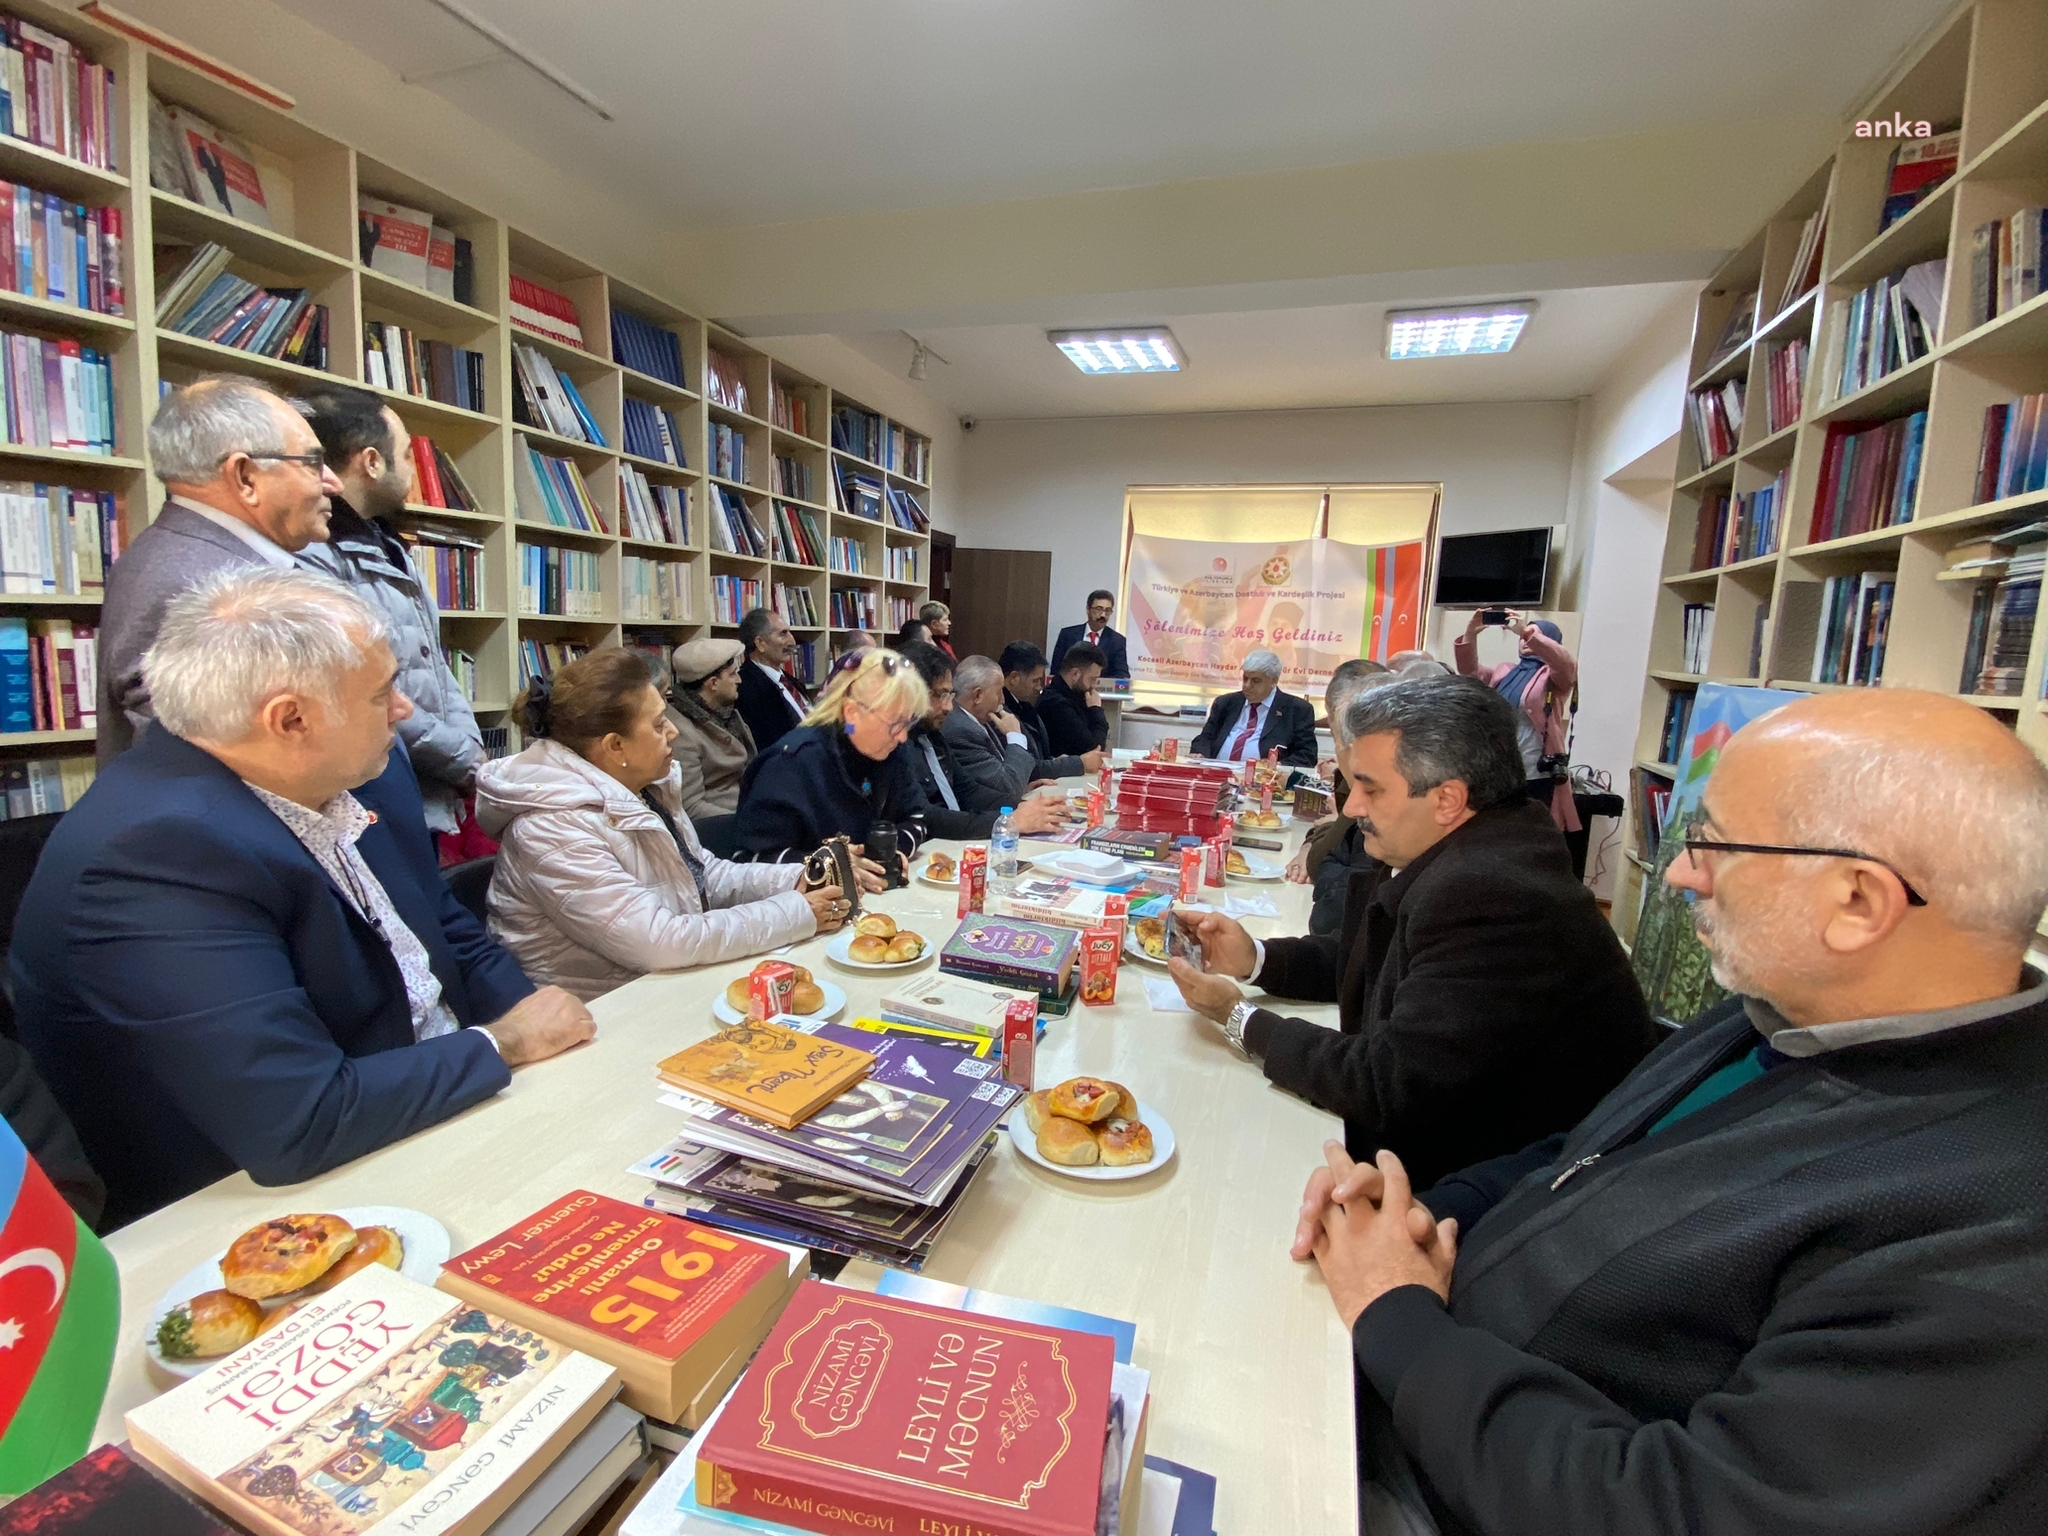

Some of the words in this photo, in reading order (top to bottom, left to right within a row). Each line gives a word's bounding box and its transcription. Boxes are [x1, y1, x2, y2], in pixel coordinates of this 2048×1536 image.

[1152, 583, 1179, 595] Türkiye
[1189, 589, 1234, 599] Azerbaycan
[1235, 590, 1265, 599] Dostluk
[1266, 591, 1276, 599] ve
[1277, 590, 1315, 600] Kardeşlik
[1316, 590, 1346, 600] Projesi
[1143, 618, 1226, 638] Şölenimize
[1231, 626, 1265, 642] Hoş
[1272, 627, 1344, 644] Geldiniz
[1137, 655, 1165, 665] Kocaeli
[1165, 658, 1209, 669] Azerbaycan
[1210, 663, 1238, 672] Haydar
[1011, 903, 1052, 915] bildiklerim
[1023, 913, 1066, 925] bildiklerim
[524, 1195, 598, 1240] Guenter
[593, 1220, 628, 1241] Ne
[460, 1240, 524, 1274] Lewy
[531, 1216, 663, 1303] Ermenilerine
[533, 1242, 593, 1284] Oldu?
[579, 1237, 663, 1297] Osmanlı
[590, 1229, 740, 1334] 1915
[300, 1305, 326, 1320] EL
[309, 1299, 352, 1329] POEMASI
[204, 1300, 386, 1415] GÖZƏL
[216, 1321, 302, 1378] DASTANI
[808, 1338, 855, 1408] NİZAMİ
[245, 1320, 414, 1431] YEDDİ
[828, 1335, 881, 1422] GƏNCƏVİ
[896, 1376, 953, 1464] LEYLİ
[930, 1332, 966, 1377] VƏ
[498, 1384, 566, 1449] NİZAMİ
[937, 1334, 1004, 1479] MƏCNUN
[398, 1451, 495, 1532] GƏNCƏVİ
[752, 1487, 813, 1514] NİZAMİ
[815, 1502, 894, 1532] GƏNCƏVİ
